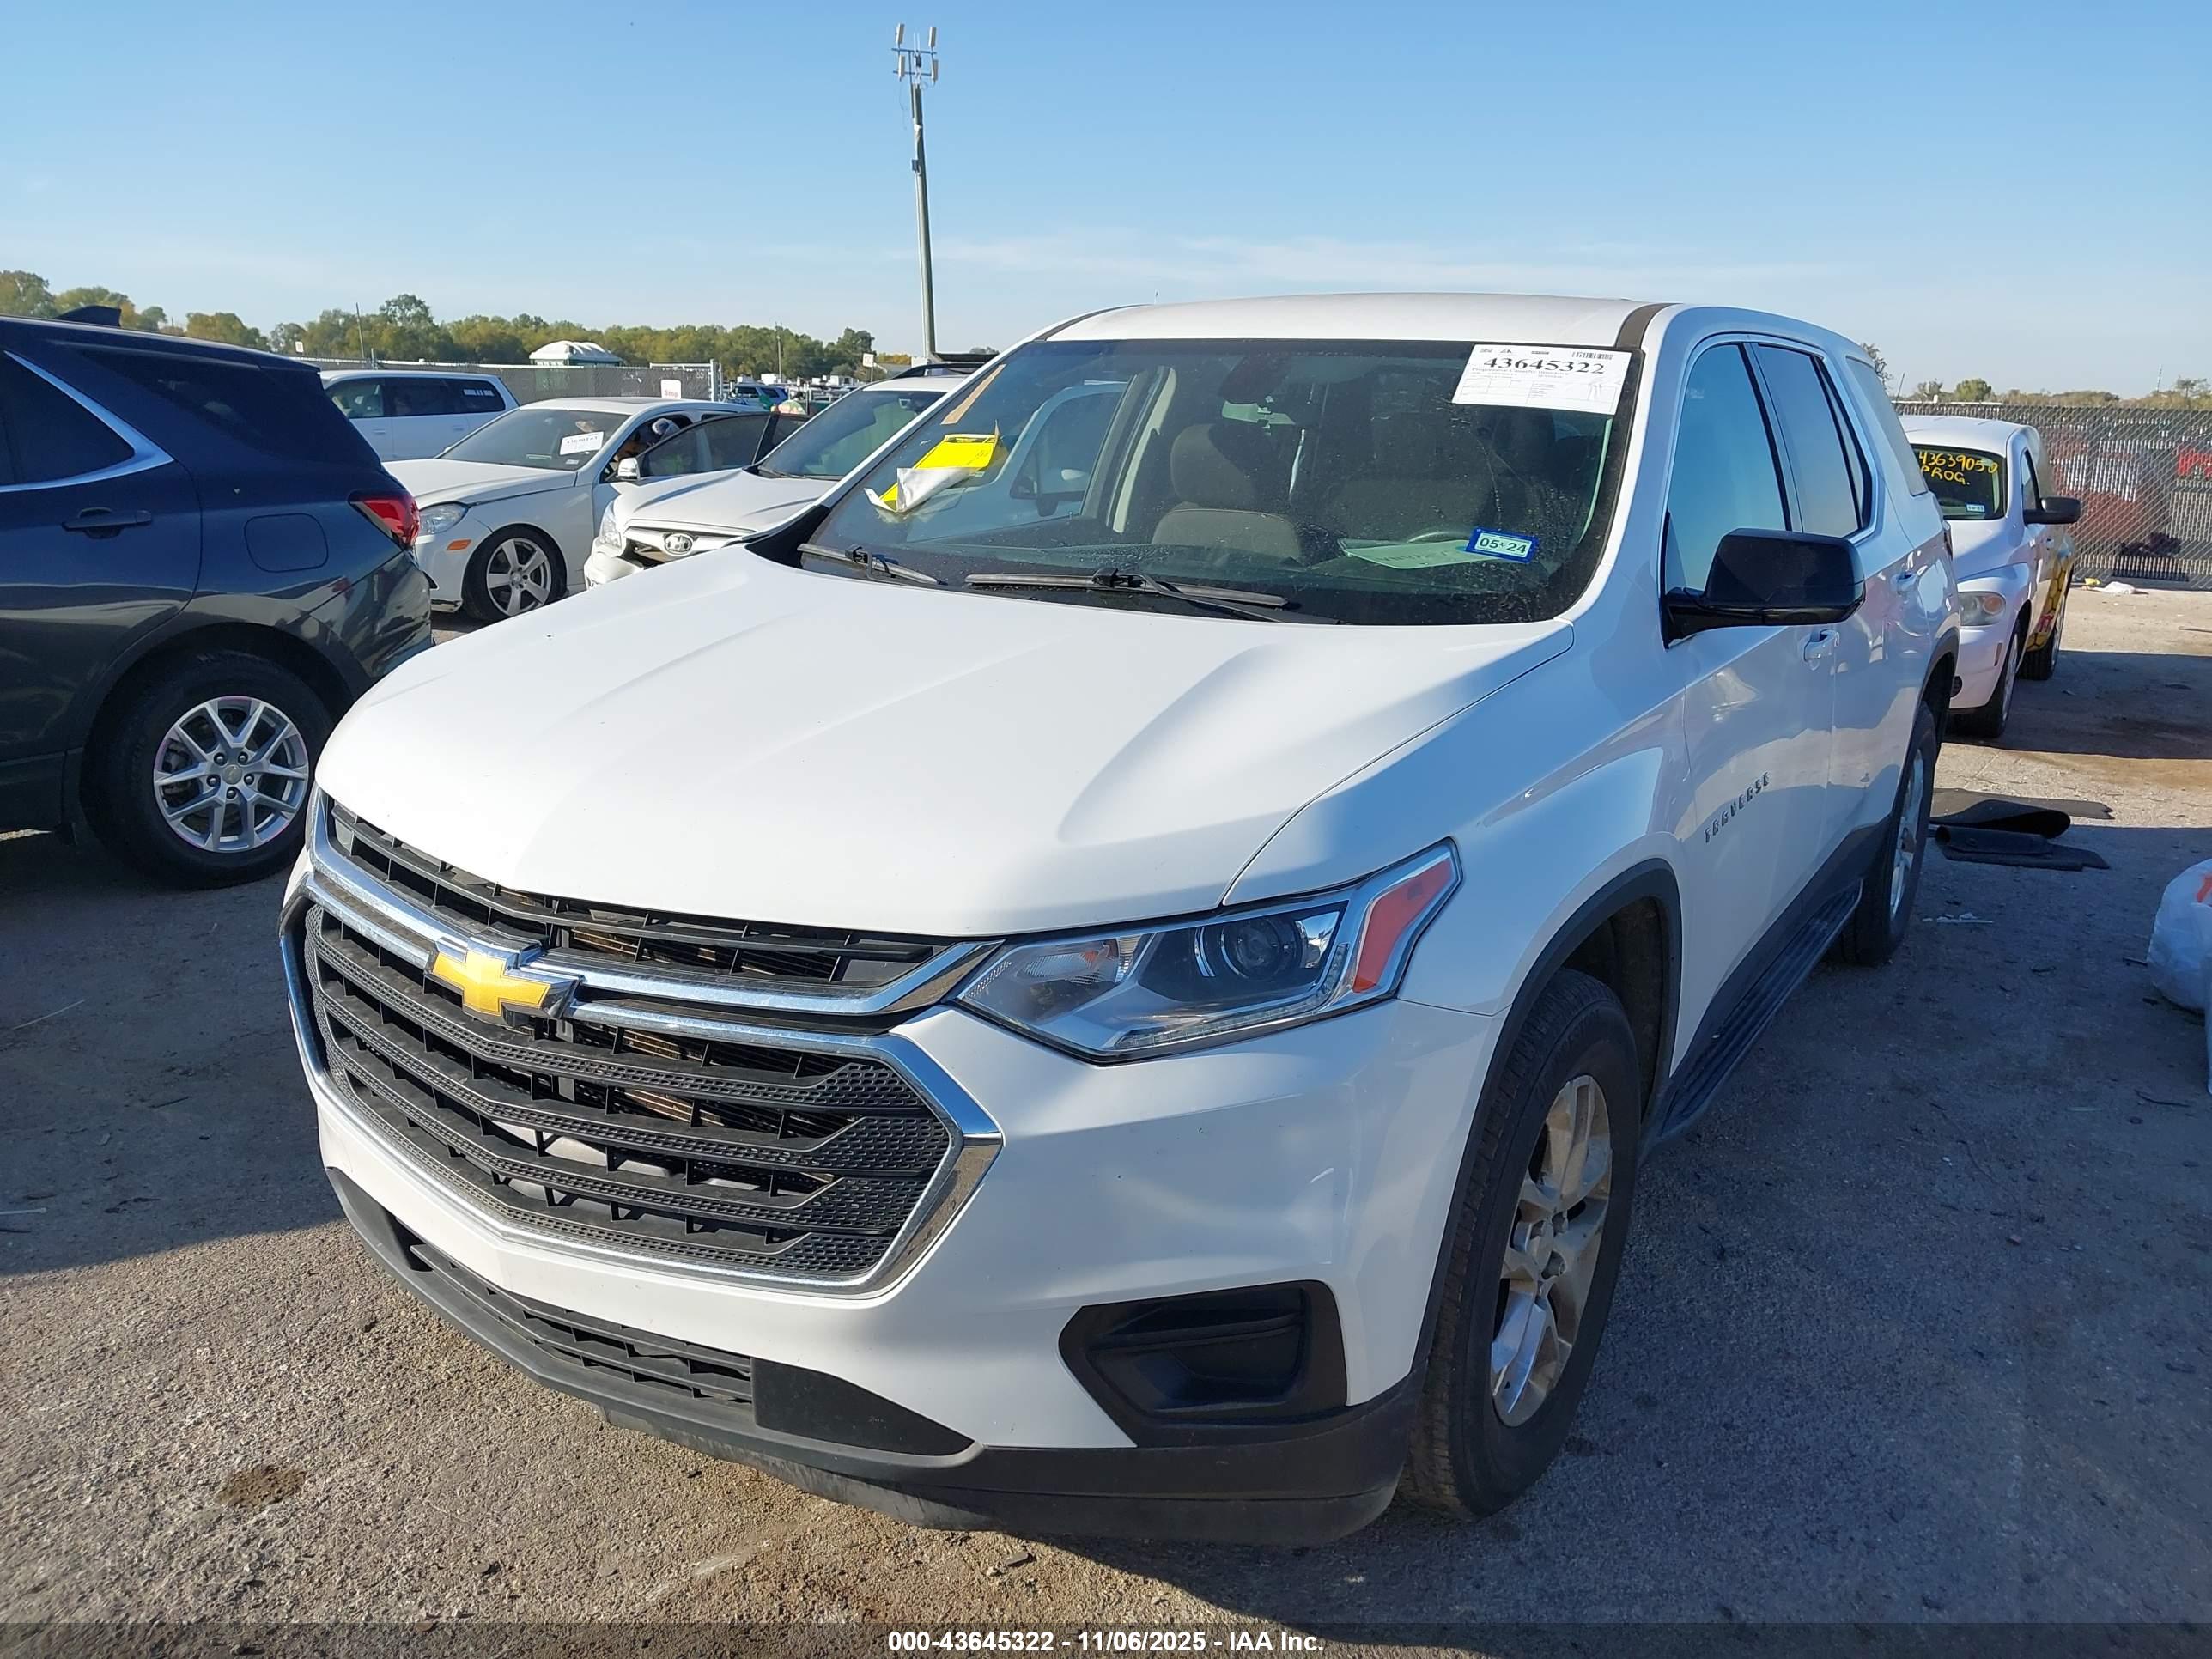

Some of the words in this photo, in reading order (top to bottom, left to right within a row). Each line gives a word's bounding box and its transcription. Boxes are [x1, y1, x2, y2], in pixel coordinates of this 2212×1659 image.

[1483, 357, 1604, 374] 43645322
[1918, 451, 1999, 474] 43639050
[1704, 771, 1770, 843] TRAVERSE
